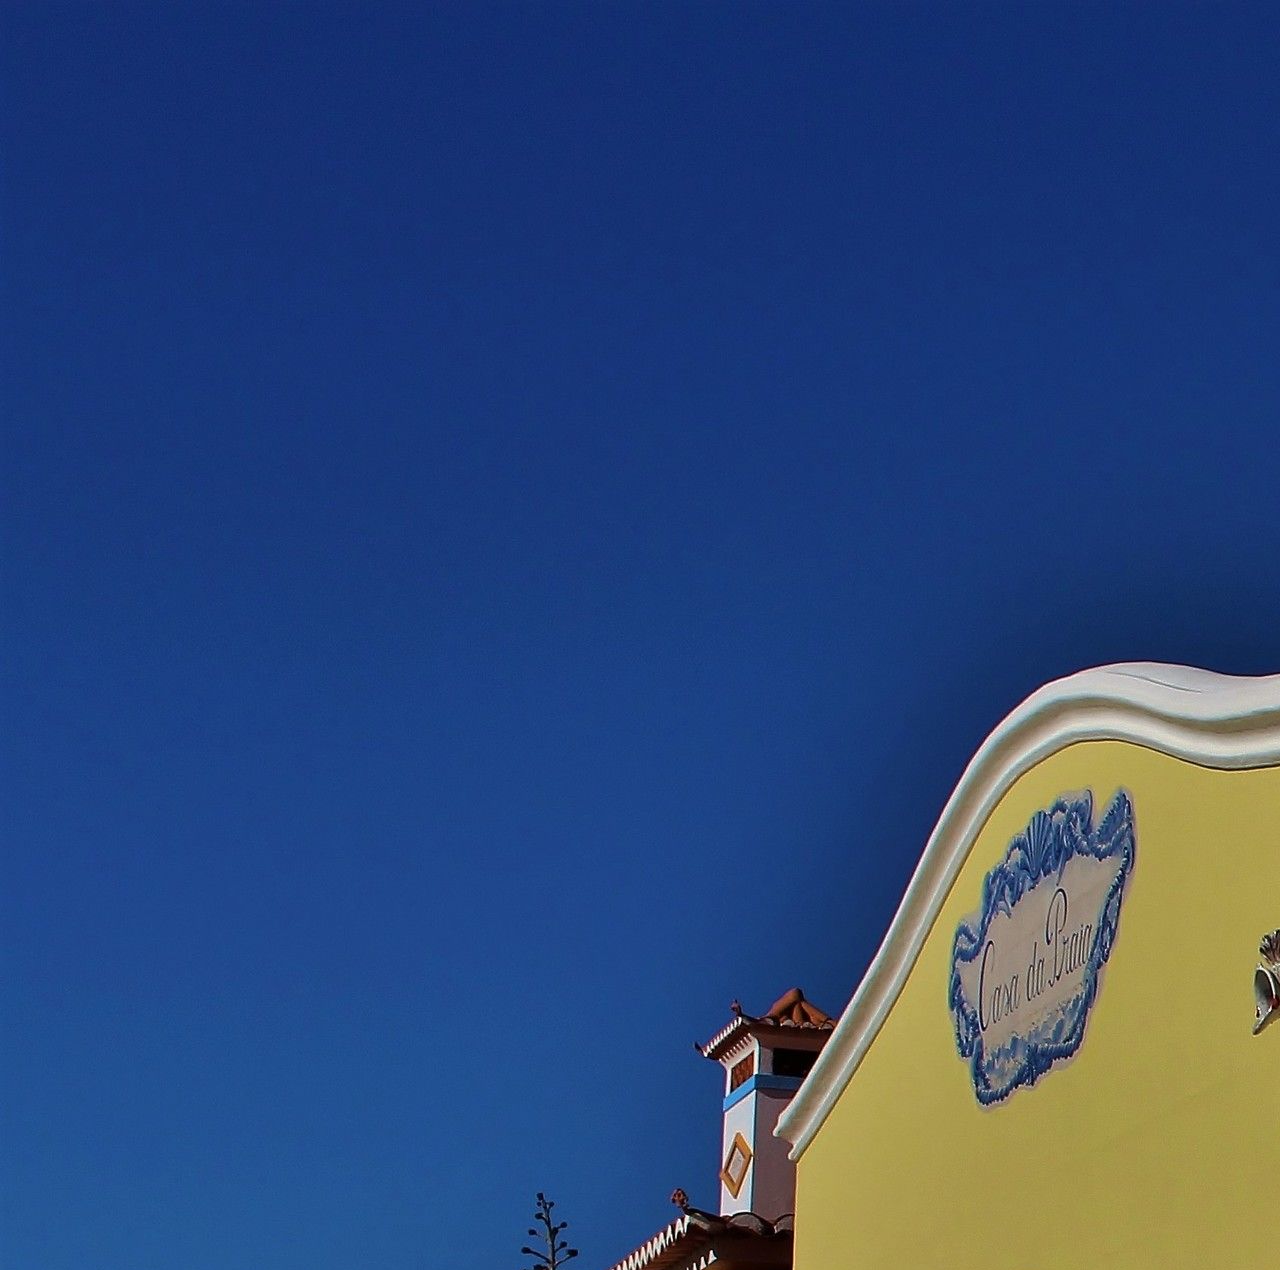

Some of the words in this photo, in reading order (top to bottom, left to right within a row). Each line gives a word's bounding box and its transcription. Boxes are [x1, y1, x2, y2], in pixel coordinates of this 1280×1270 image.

[979, 940, 1019, 1031] Casa
[1027, 942, 1045, 1001] da
[1046, 888, 1092, 987] Praia
